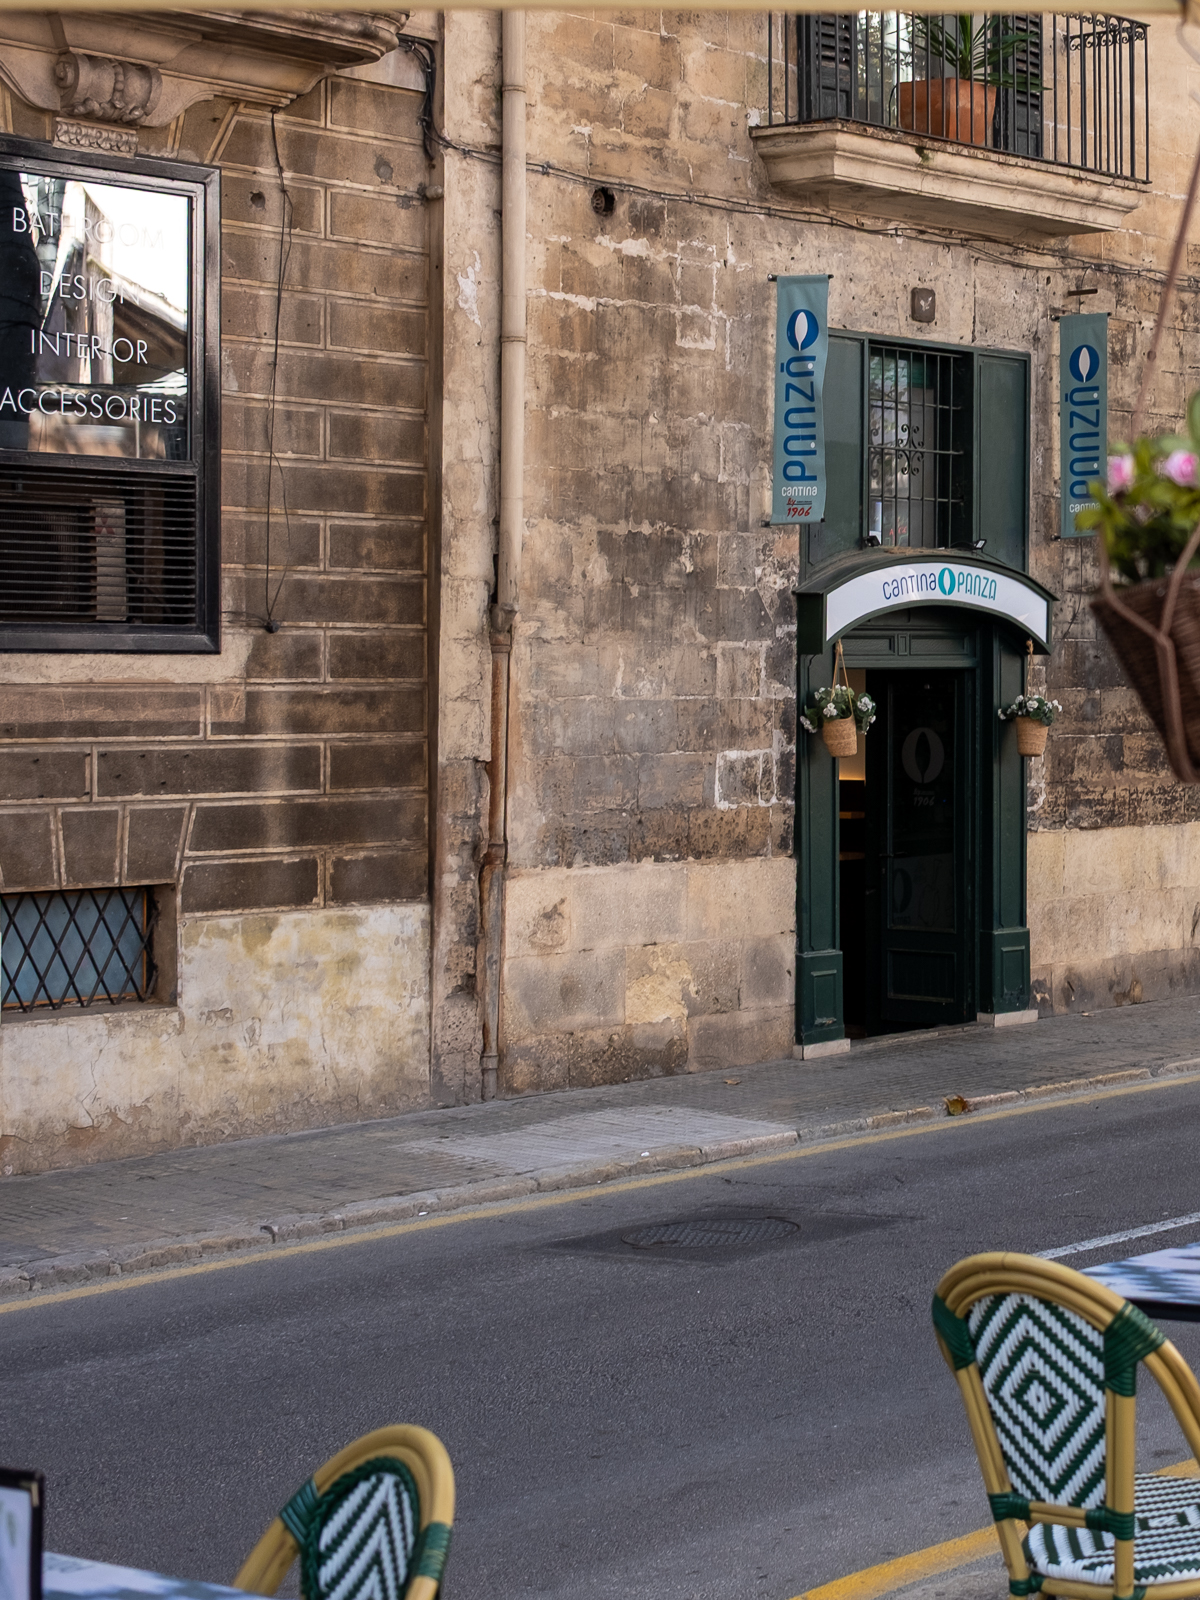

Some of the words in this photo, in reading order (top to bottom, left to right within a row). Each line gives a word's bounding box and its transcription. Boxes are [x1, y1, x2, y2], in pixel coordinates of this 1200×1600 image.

[13, 206, 165, 250] BATHROOM
[40, 270, 141, 306] DESIGN
[31, 329, 149, 365] INTERIOR
[0, 386, 178, 425] ACCESSORIES
[787, 506, 813, 518] 1906
